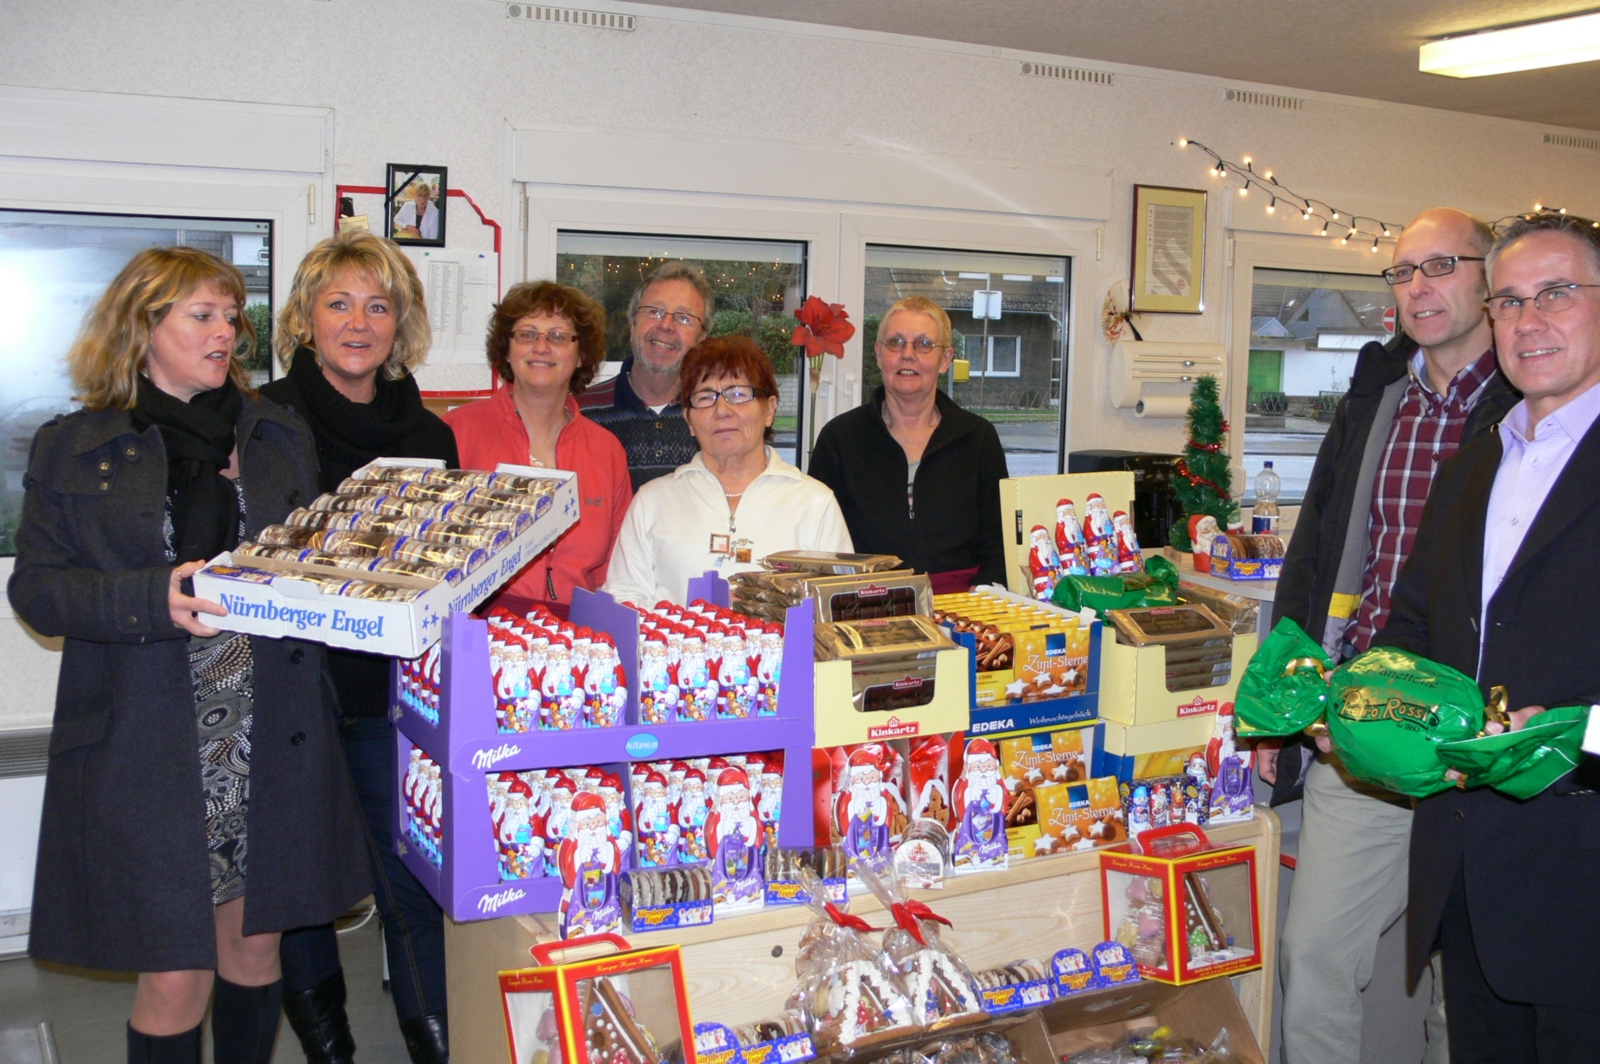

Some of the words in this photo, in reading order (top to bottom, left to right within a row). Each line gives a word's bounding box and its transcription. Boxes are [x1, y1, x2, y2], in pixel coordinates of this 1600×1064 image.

[448, 569, 499, 612] Nürnberger
[500, 545, 522, 577] Engel
[220, 593, 327, 630] Nürnberger
[331, 609, 384, 640] Engel
[1045, 648, 1066, 656] EDEKA
[1023, 654, 1089, 673] Zimt-Sterne
[895, 680, 921, 688] Kinkartz
[1179, 704, 1215, 715] Kinkartz
[971, 718, 1015, 733] EDEKA
[1029, 708, 1092, 725] Weihnachtsgebäck
[1404, 722, 1420, 733] 1860
[870, 725, 916, 737] Kinkartz
[1032, 743, 1053, 751] EDEKA
[471, 743, 521, 770] Milka
[1012, 750, 1079, 769] Zimt-Sterne
[1049, 806, 1115, 826] Zimt-Sterne
[979, 842, 1002, 854] Milka
[734, 877, 758, 891] Milka
[477, 888, 526, 913] Milka
[592, 904, 616, 921] Milka
